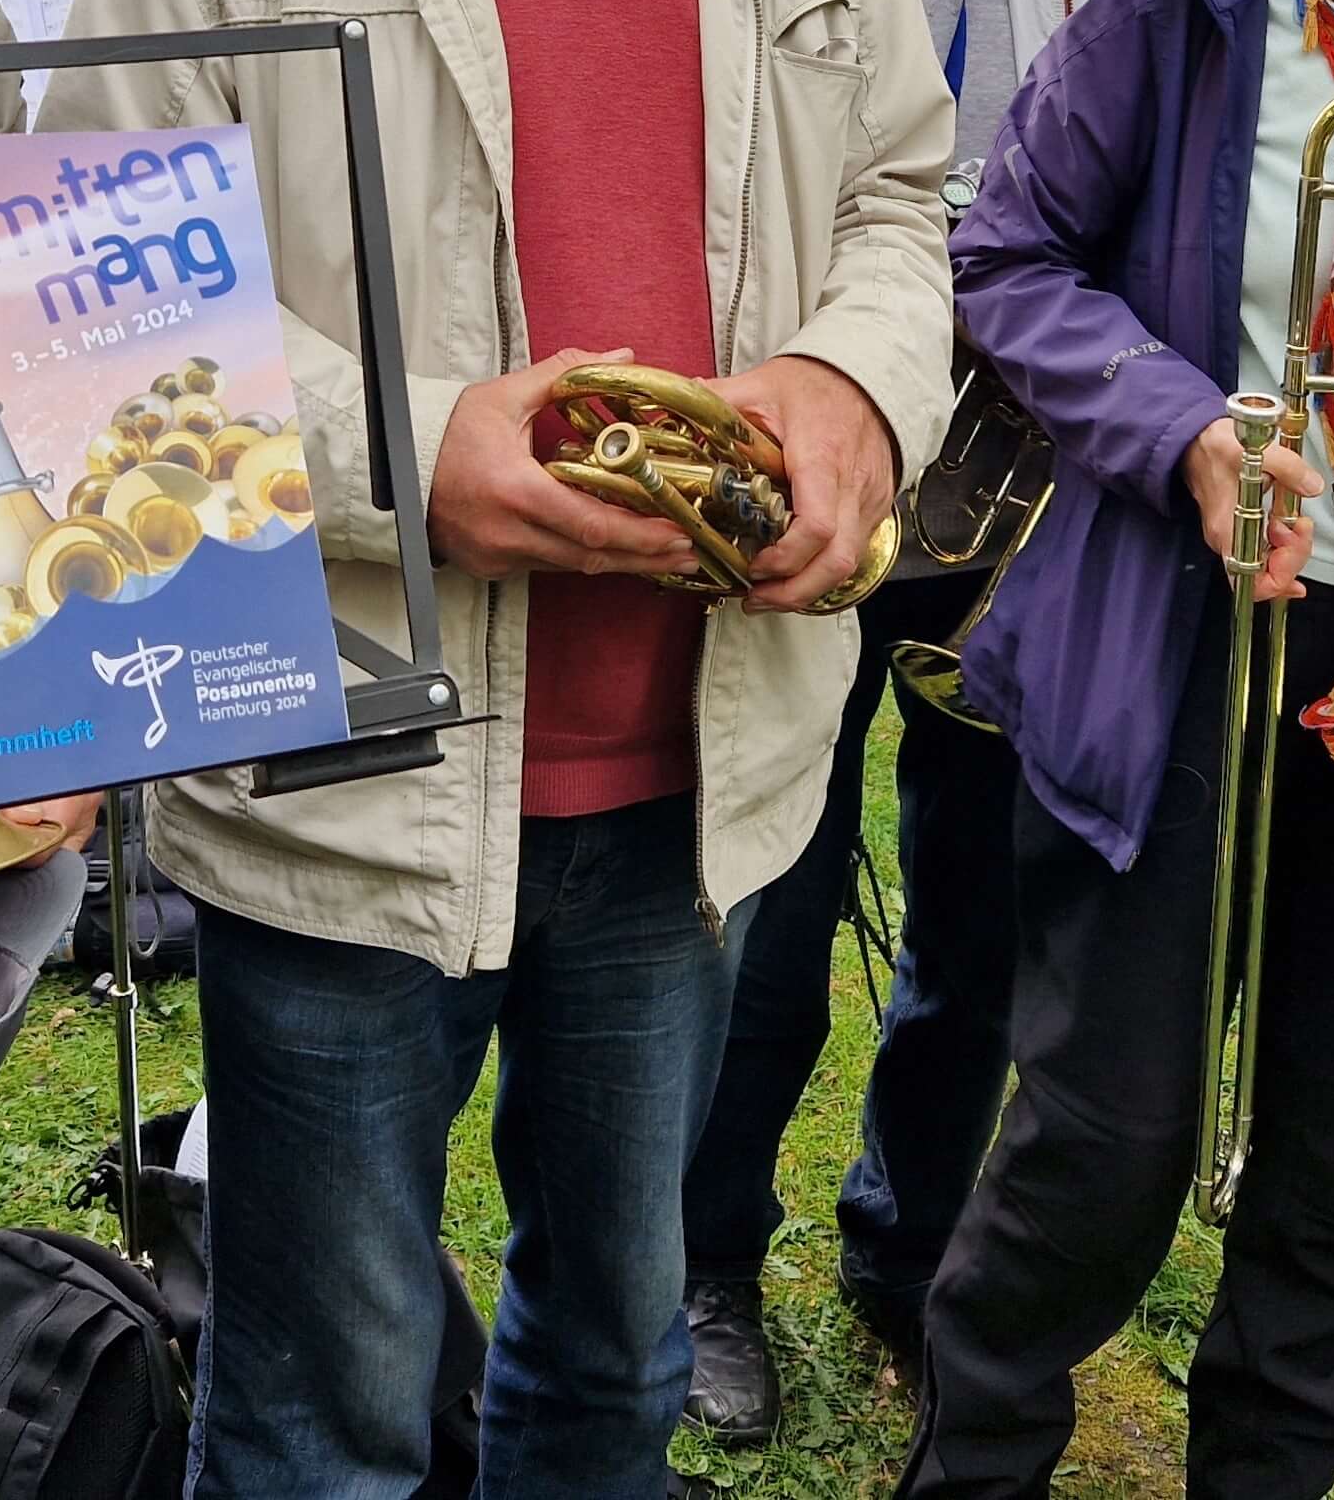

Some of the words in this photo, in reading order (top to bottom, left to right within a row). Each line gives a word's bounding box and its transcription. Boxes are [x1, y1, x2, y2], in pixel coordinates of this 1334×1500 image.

[34, 216, 238, 325] mang
[80, 320, 126, 352] Mai
[131, 299, 194, 335] 2024
[190, 641, 269, 666] Deutscher
[193, 656, 298, 685] Evangelischer
[195, 672, 316, 705] Posaunentag
[199, 699, 272, 724] Hamburg
[275, 694, 307, 711] 2024
